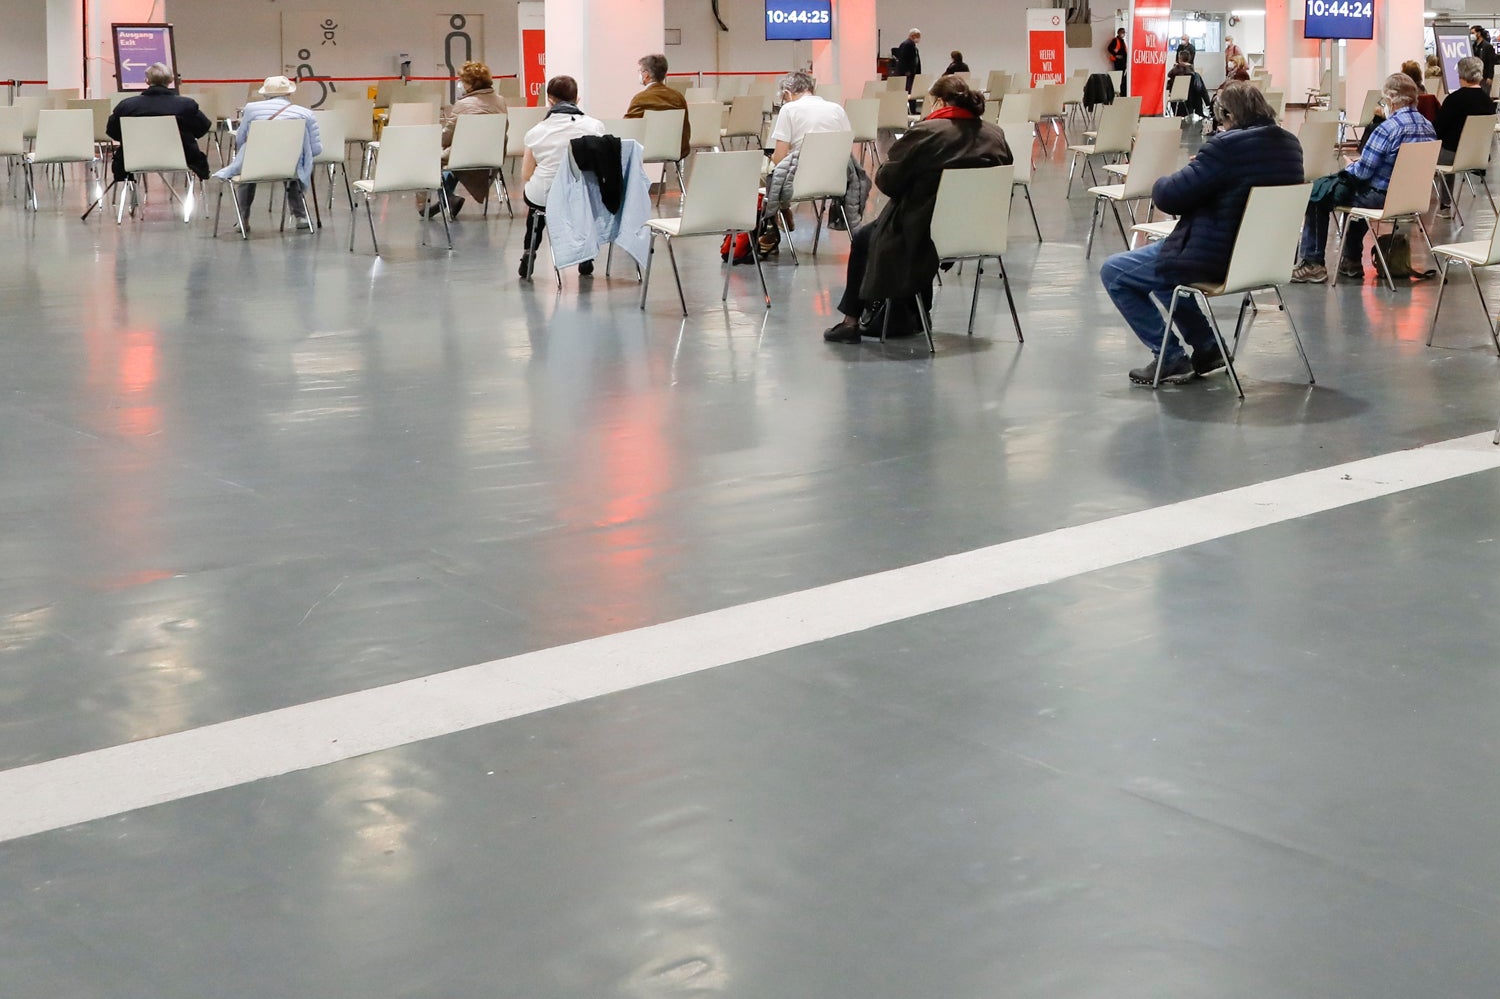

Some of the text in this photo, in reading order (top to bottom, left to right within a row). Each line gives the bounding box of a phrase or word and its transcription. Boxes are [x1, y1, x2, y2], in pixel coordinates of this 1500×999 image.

[766, 10, 829, 23] 10:44:25
[1307, 0, 1372, 18] 10:44:24
[119, 31, 154, 40] Ausgang
[1441, 41, 1466, 58] WC
